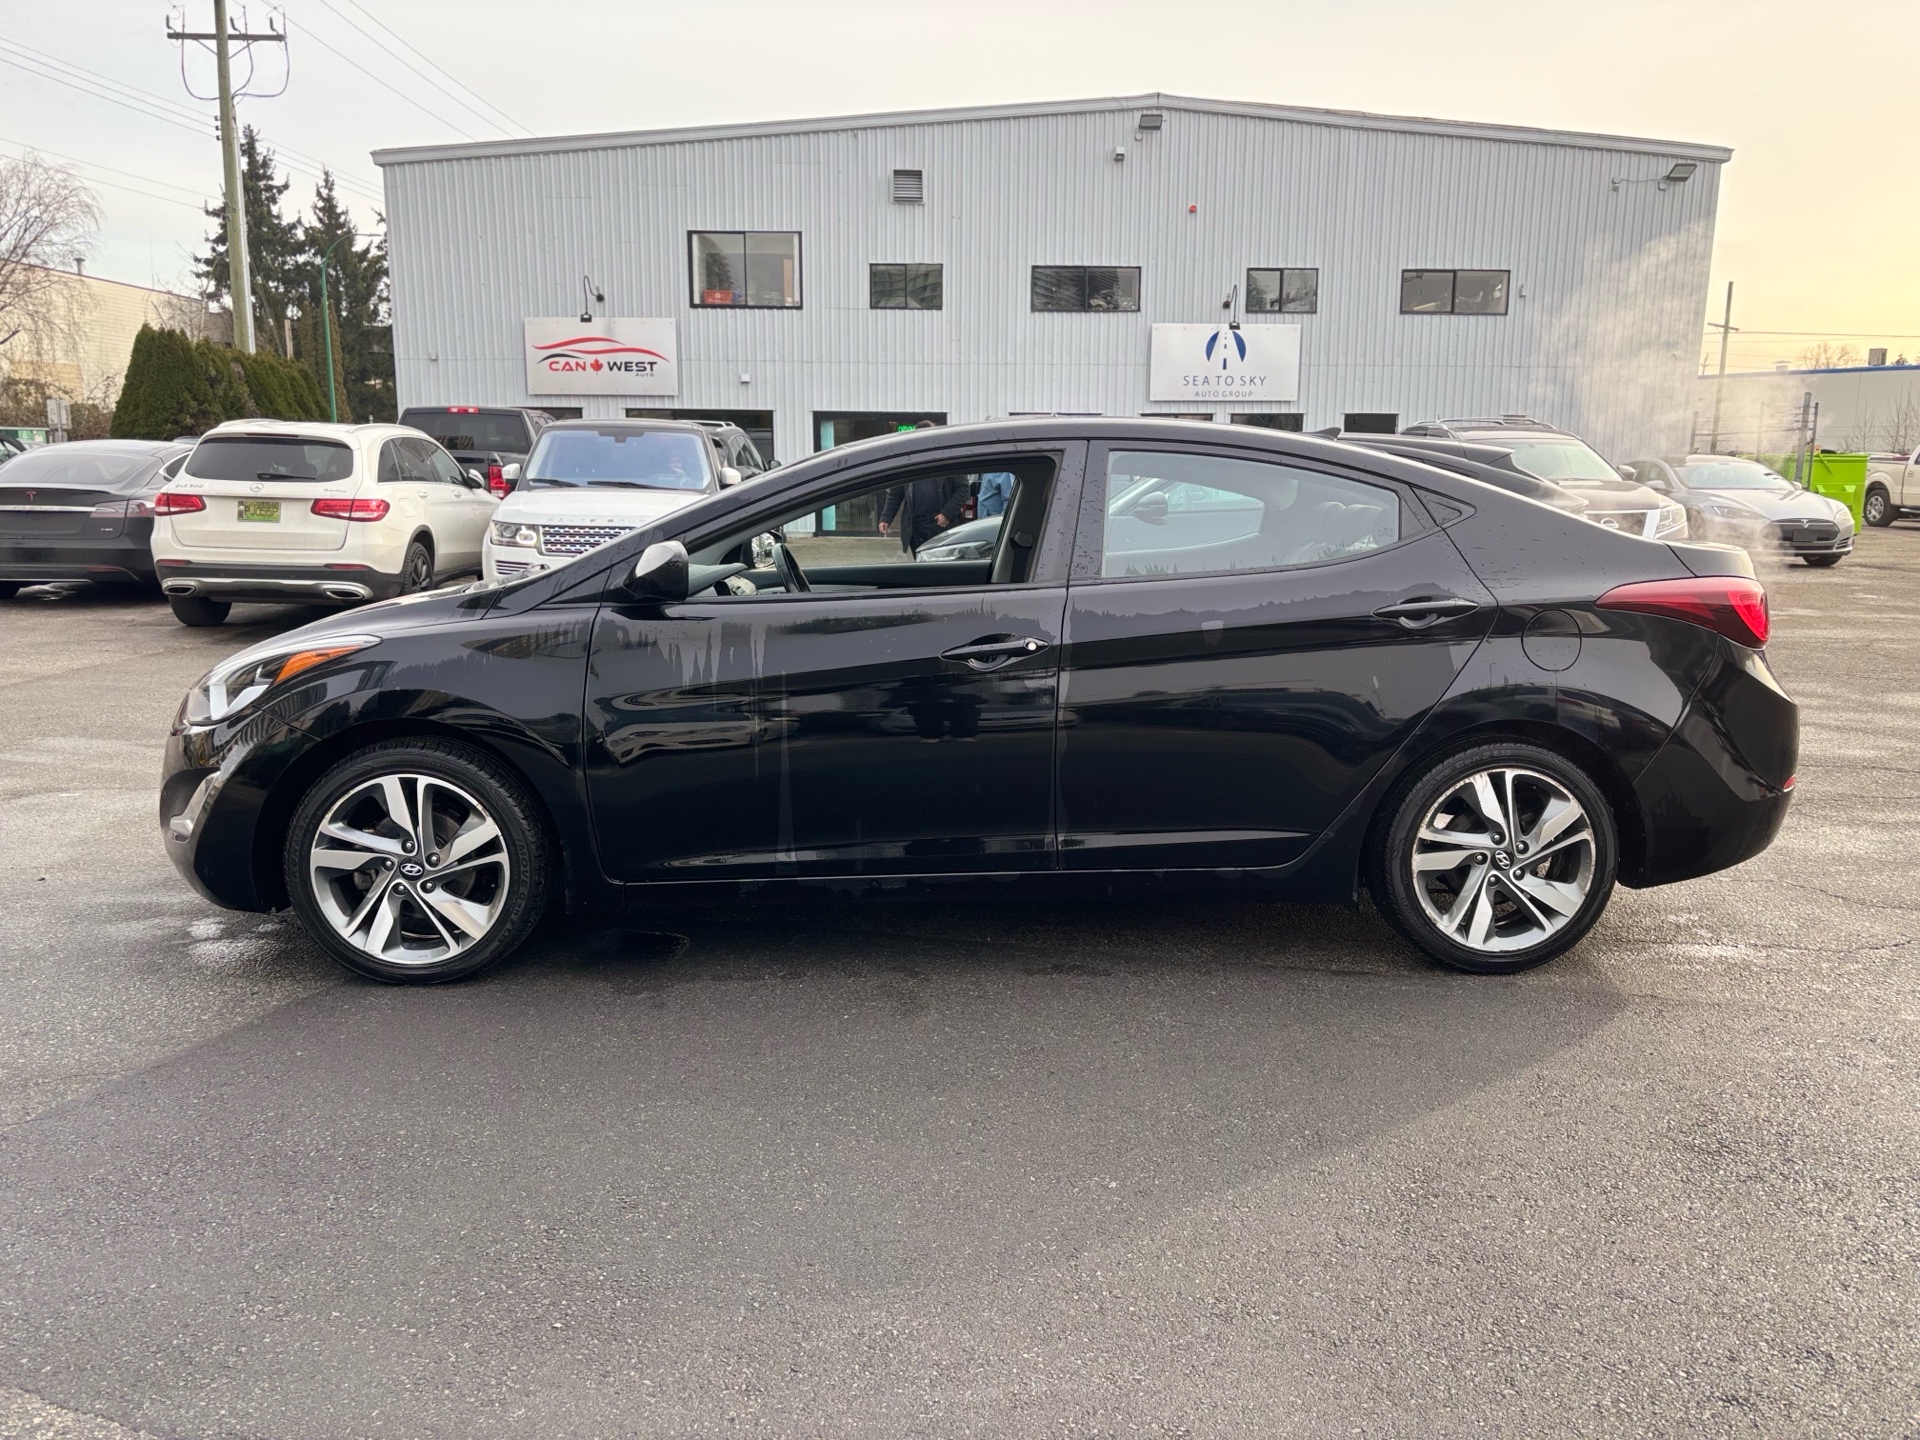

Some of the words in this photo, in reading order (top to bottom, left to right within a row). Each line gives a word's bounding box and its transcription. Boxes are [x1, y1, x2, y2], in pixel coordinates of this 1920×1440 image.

[548, 361, 587, 372] CAN
[607, 361, 658, 372] WEST
[1183, 375, 1210, 387] SEA
[1215, 375, 1235, 387] TO
[1239, 375, 1267, 387] SKY
[1194, 390, 1219, 398] AUTO
[1221, 390, 1254, 398] GROUP
